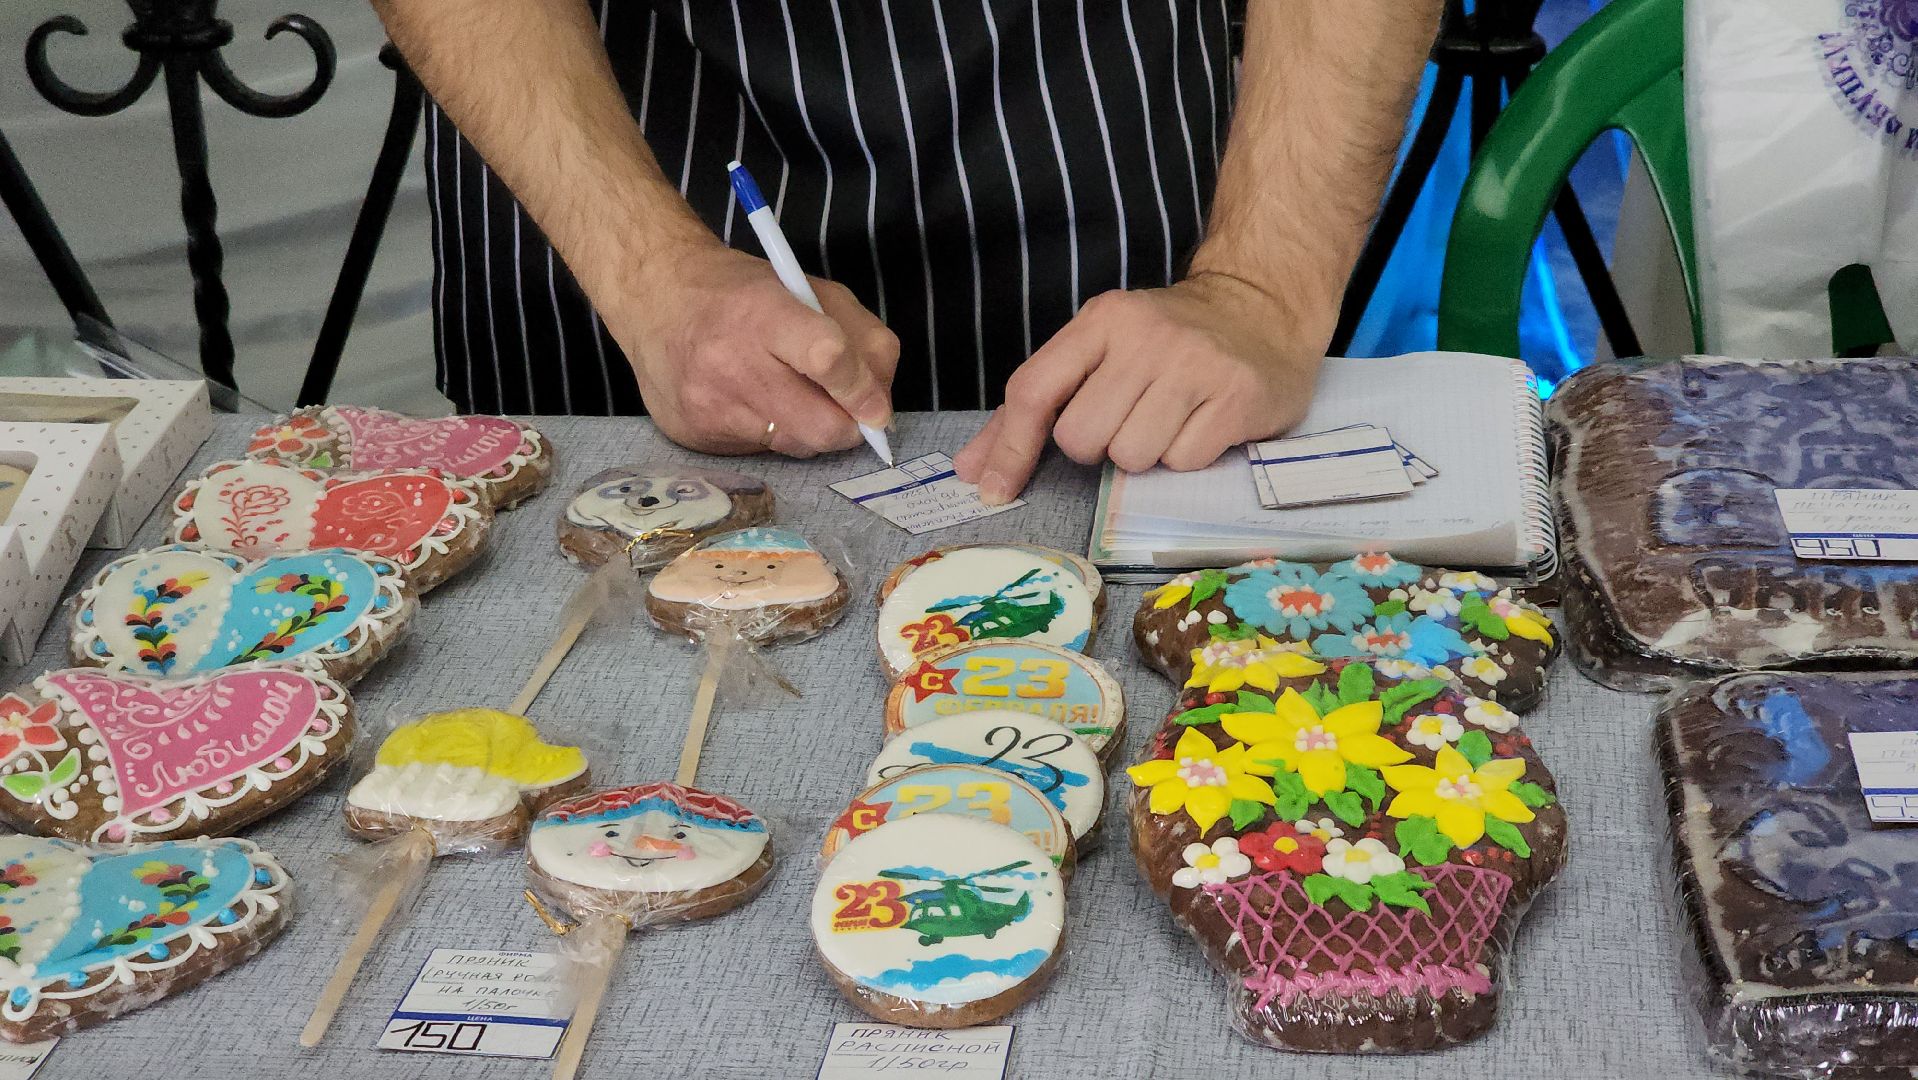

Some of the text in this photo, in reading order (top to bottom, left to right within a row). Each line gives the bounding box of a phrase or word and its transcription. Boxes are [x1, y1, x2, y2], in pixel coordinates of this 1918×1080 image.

[920, 656, 1070, 698] С 23
[852, 809, 878, 830] С
[836, 881, 907, 928] 23
[448, 955, 530, 968] ПРЯНИК
[438, 985, 465, 995] НА
[850, 1028, 951, 1040] ПРЯНИК
[837, 1040, 1001, 1054] РАСПИСНОЙ
